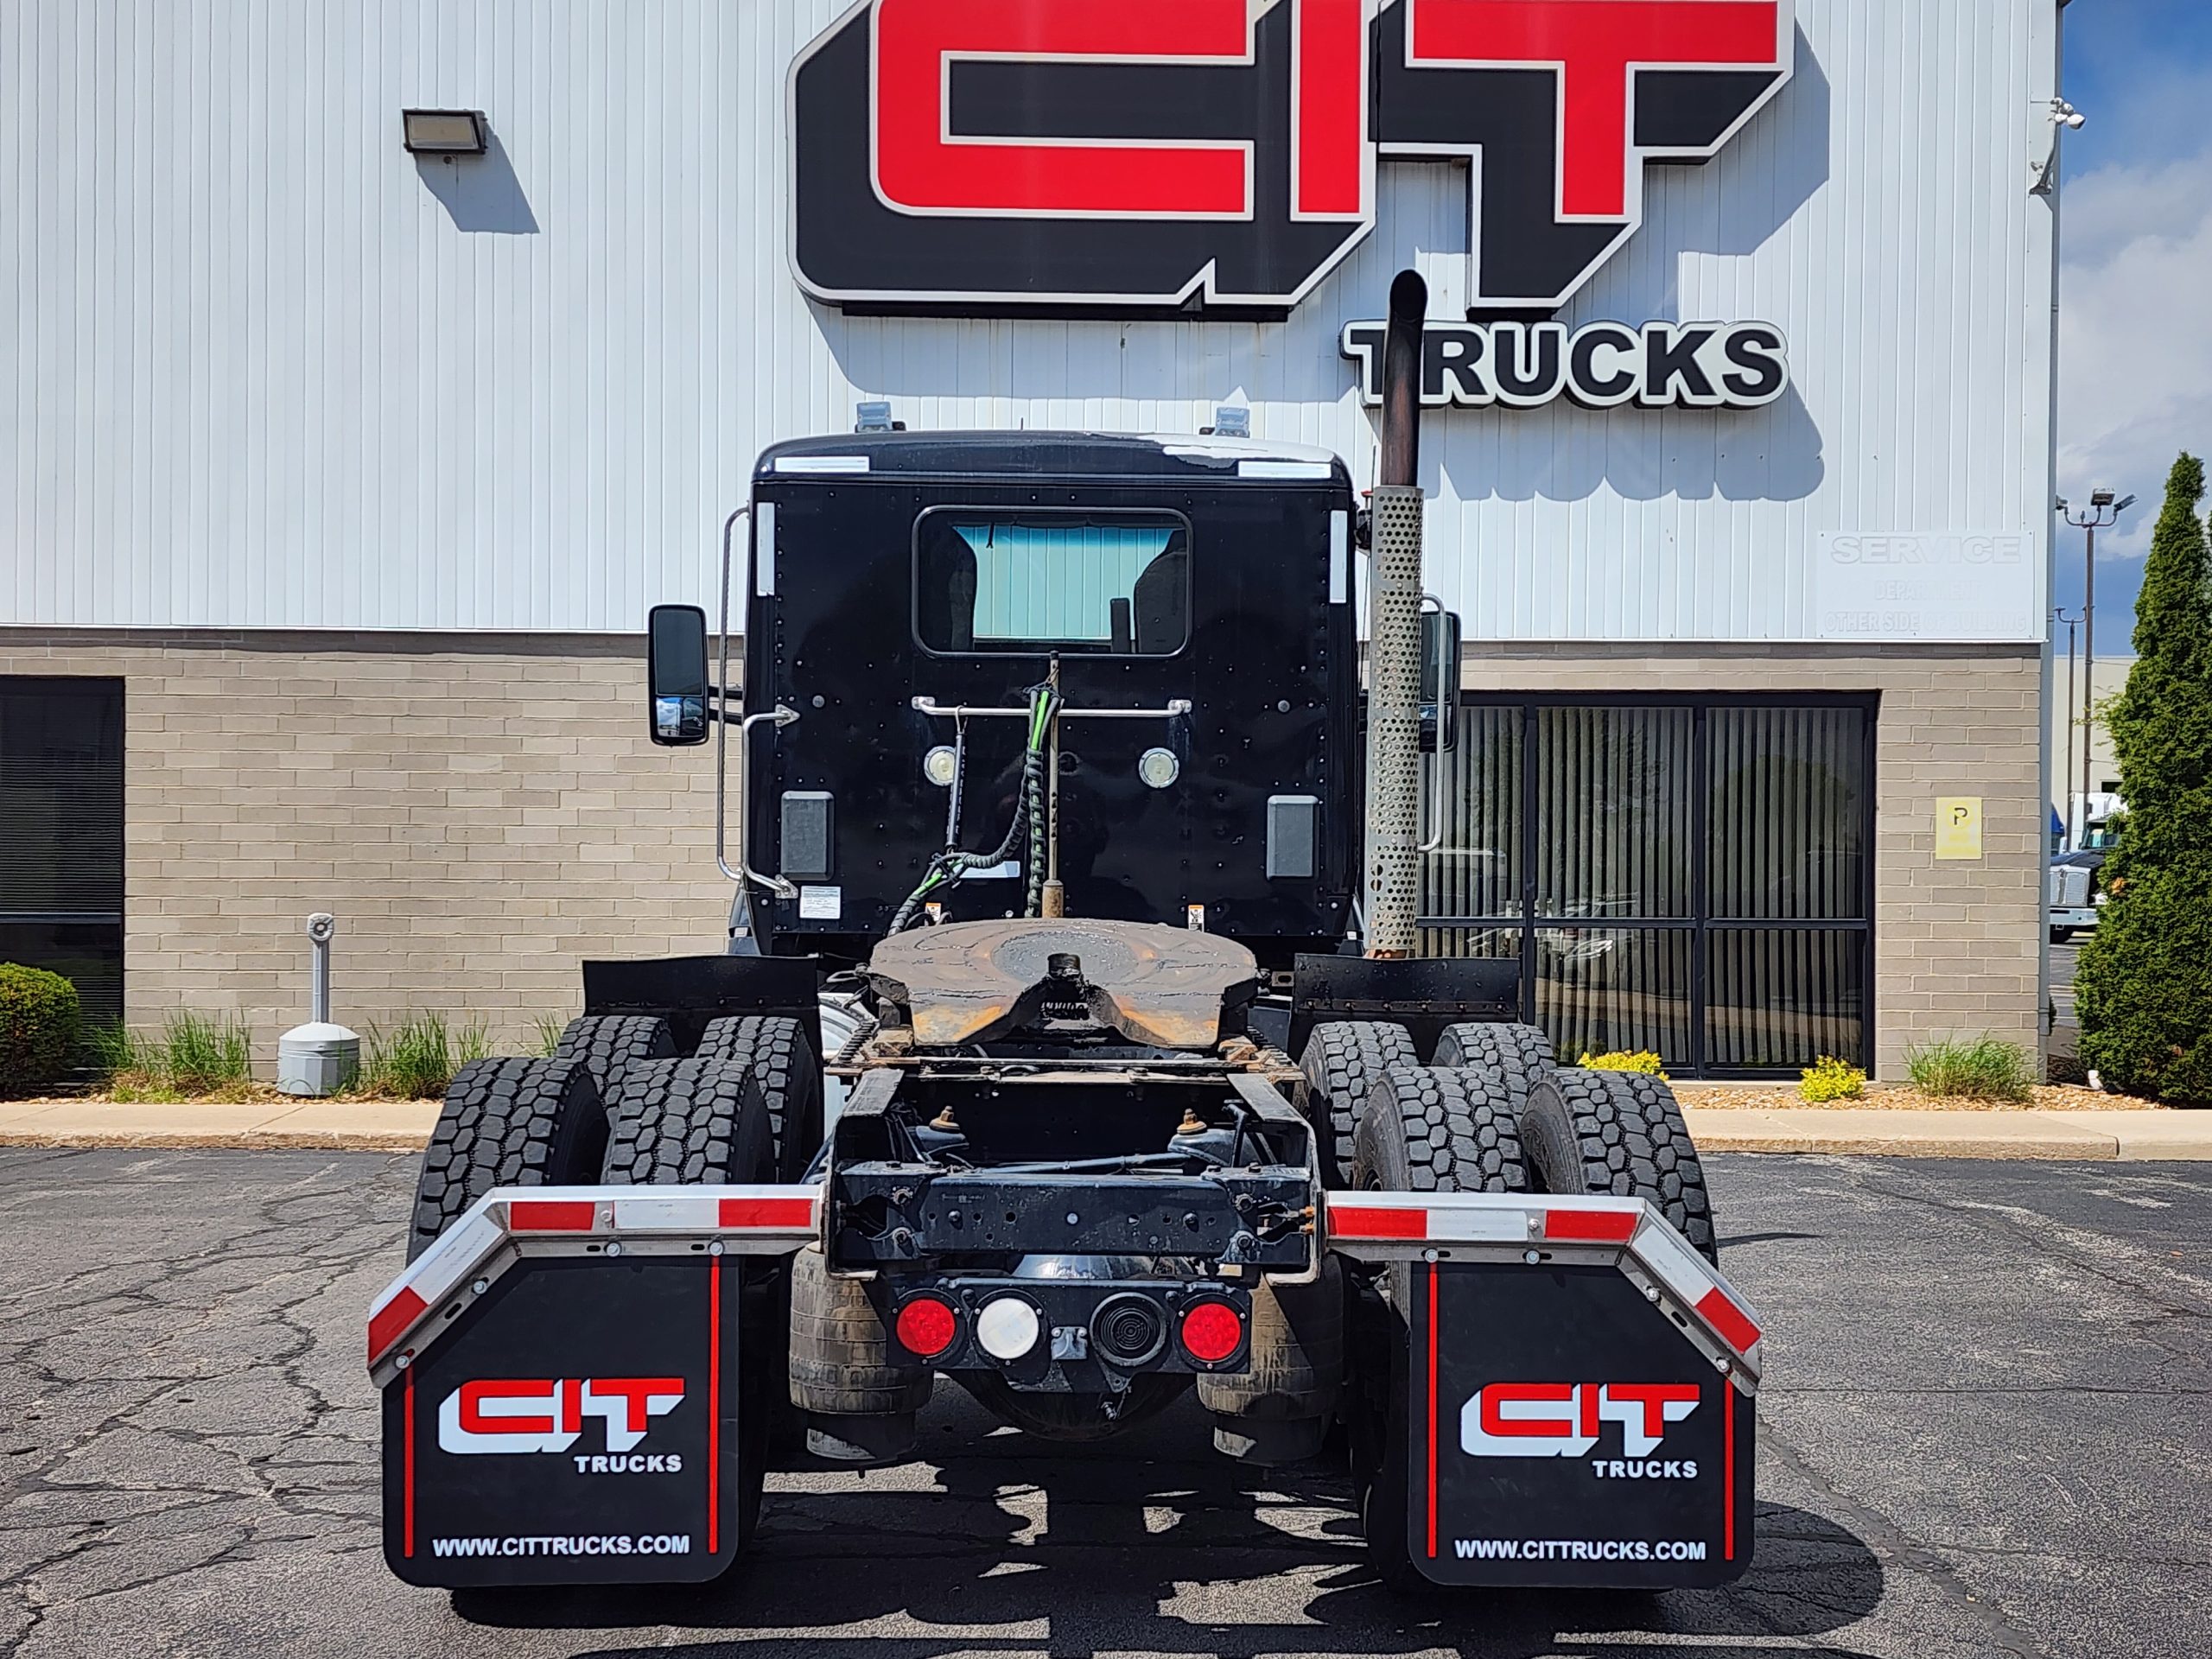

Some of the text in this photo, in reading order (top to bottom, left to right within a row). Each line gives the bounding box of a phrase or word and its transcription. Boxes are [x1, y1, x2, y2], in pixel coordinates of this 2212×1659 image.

[788, 0, 1794, 309] CIT
[1348, 327, 1784, 400] TRUCKS
[1831, 536, 2022, 564] SERVICE
[1875, 580, 1983, 601] DEPARENT
[1824, 611, 1879, 632] OTHER
[1883, 611, 1920, 632] SIDE
[439, 1377, 685, 1453] CIT
[1461, 1382, 1700, 1457] CIT
[573, 1454, 682, 1473] TRUCKS
[1592, 1460, 1698, 1478] TRUCKS
[432, 1535, 690, 1557] WWW.CITTRUCKS.COM
[1455, 1540, 1707, 1560] WWW.CITTRUCKS.COM
